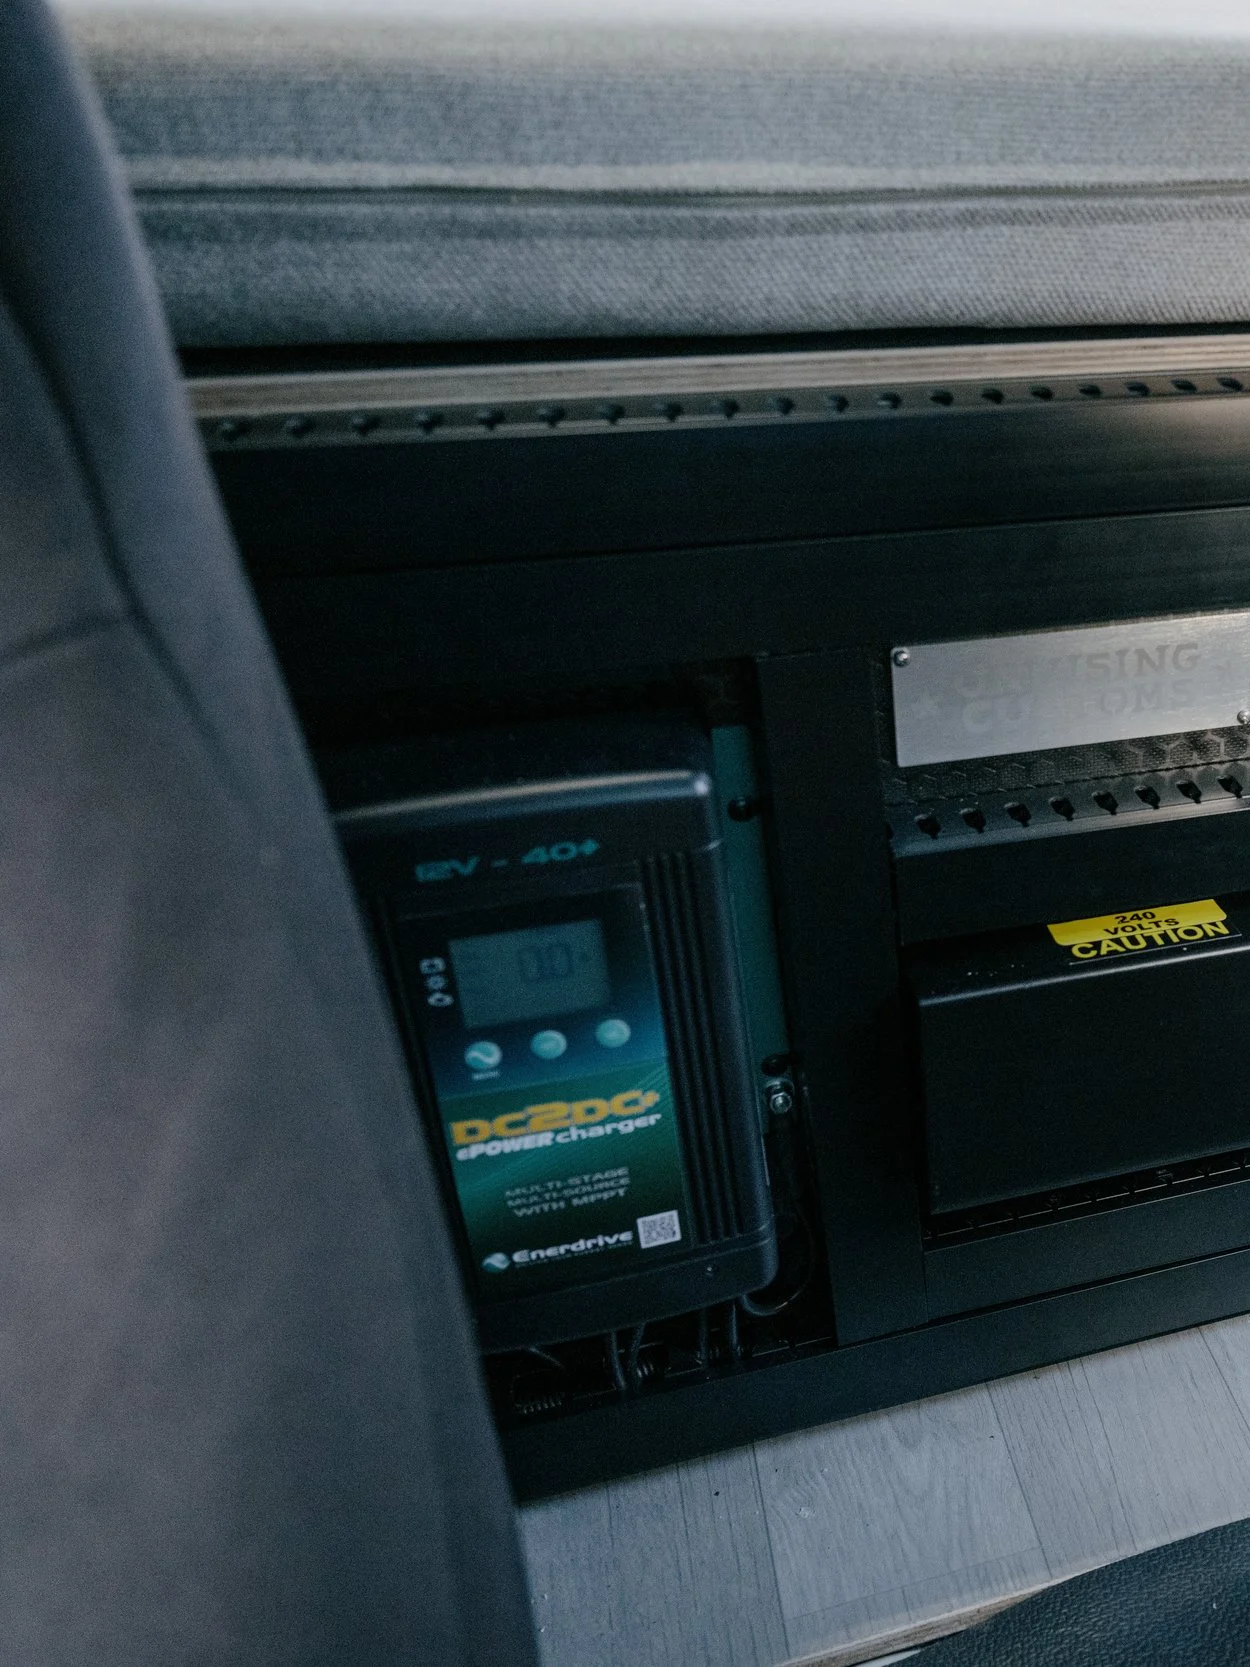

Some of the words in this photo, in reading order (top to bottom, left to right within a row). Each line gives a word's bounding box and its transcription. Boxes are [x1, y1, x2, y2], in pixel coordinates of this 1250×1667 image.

[1104, 919, 1180, 936] VOLTS
[1115, 911, 1156, 924] 240
[1071, 920, 1230, 958] CAUTION
[555, 1113, 661, 1143] charger
[505, 1166, 630, 1196] MULTI-STAGE
[513, 1199, 566, 1217] WITH
[511, 1230, 634, 1263] Enerdrive
